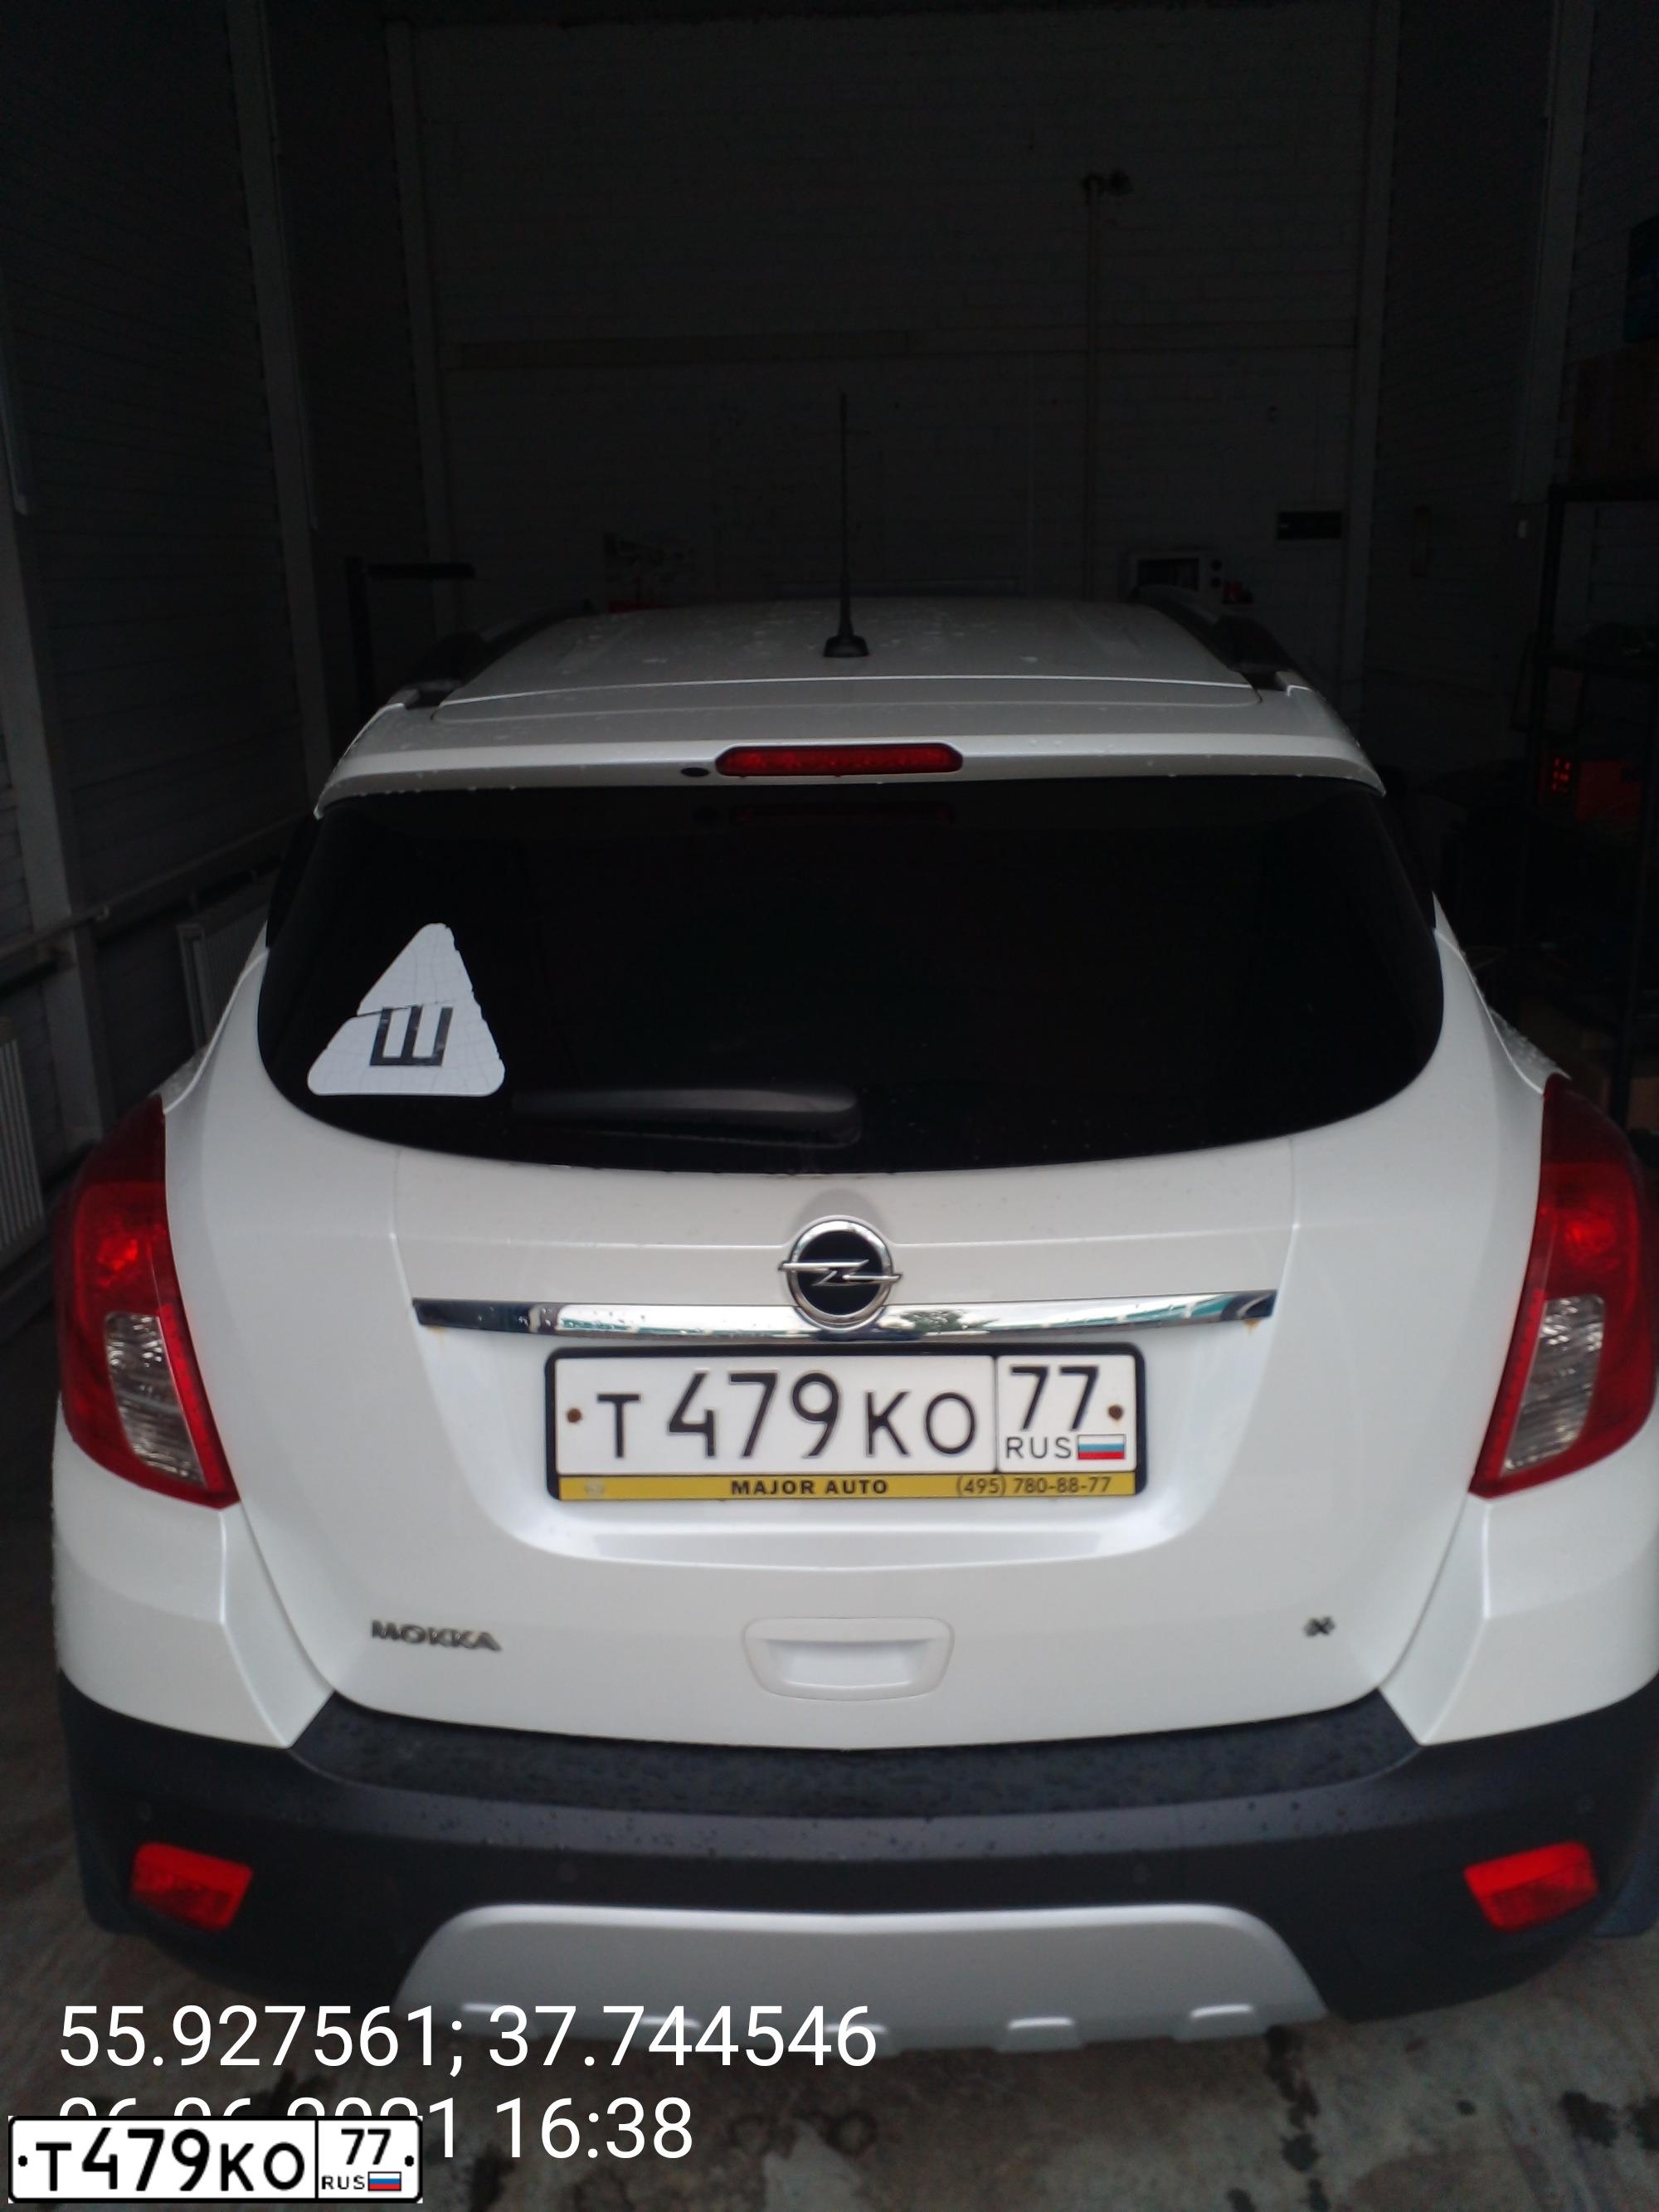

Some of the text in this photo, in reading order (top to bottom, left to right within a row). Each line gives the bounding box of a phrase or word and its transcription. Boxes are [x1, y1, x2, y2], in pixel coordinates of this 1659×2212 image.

[1010, 1365, 1100, 1432] 77
[1005, 1436, 1073, 1459] RUS
[732, 1475, 1112, 1496] MAJOR AUTO (495) 780-88-77
[371, 1620, 502, 1653] MOKKA
